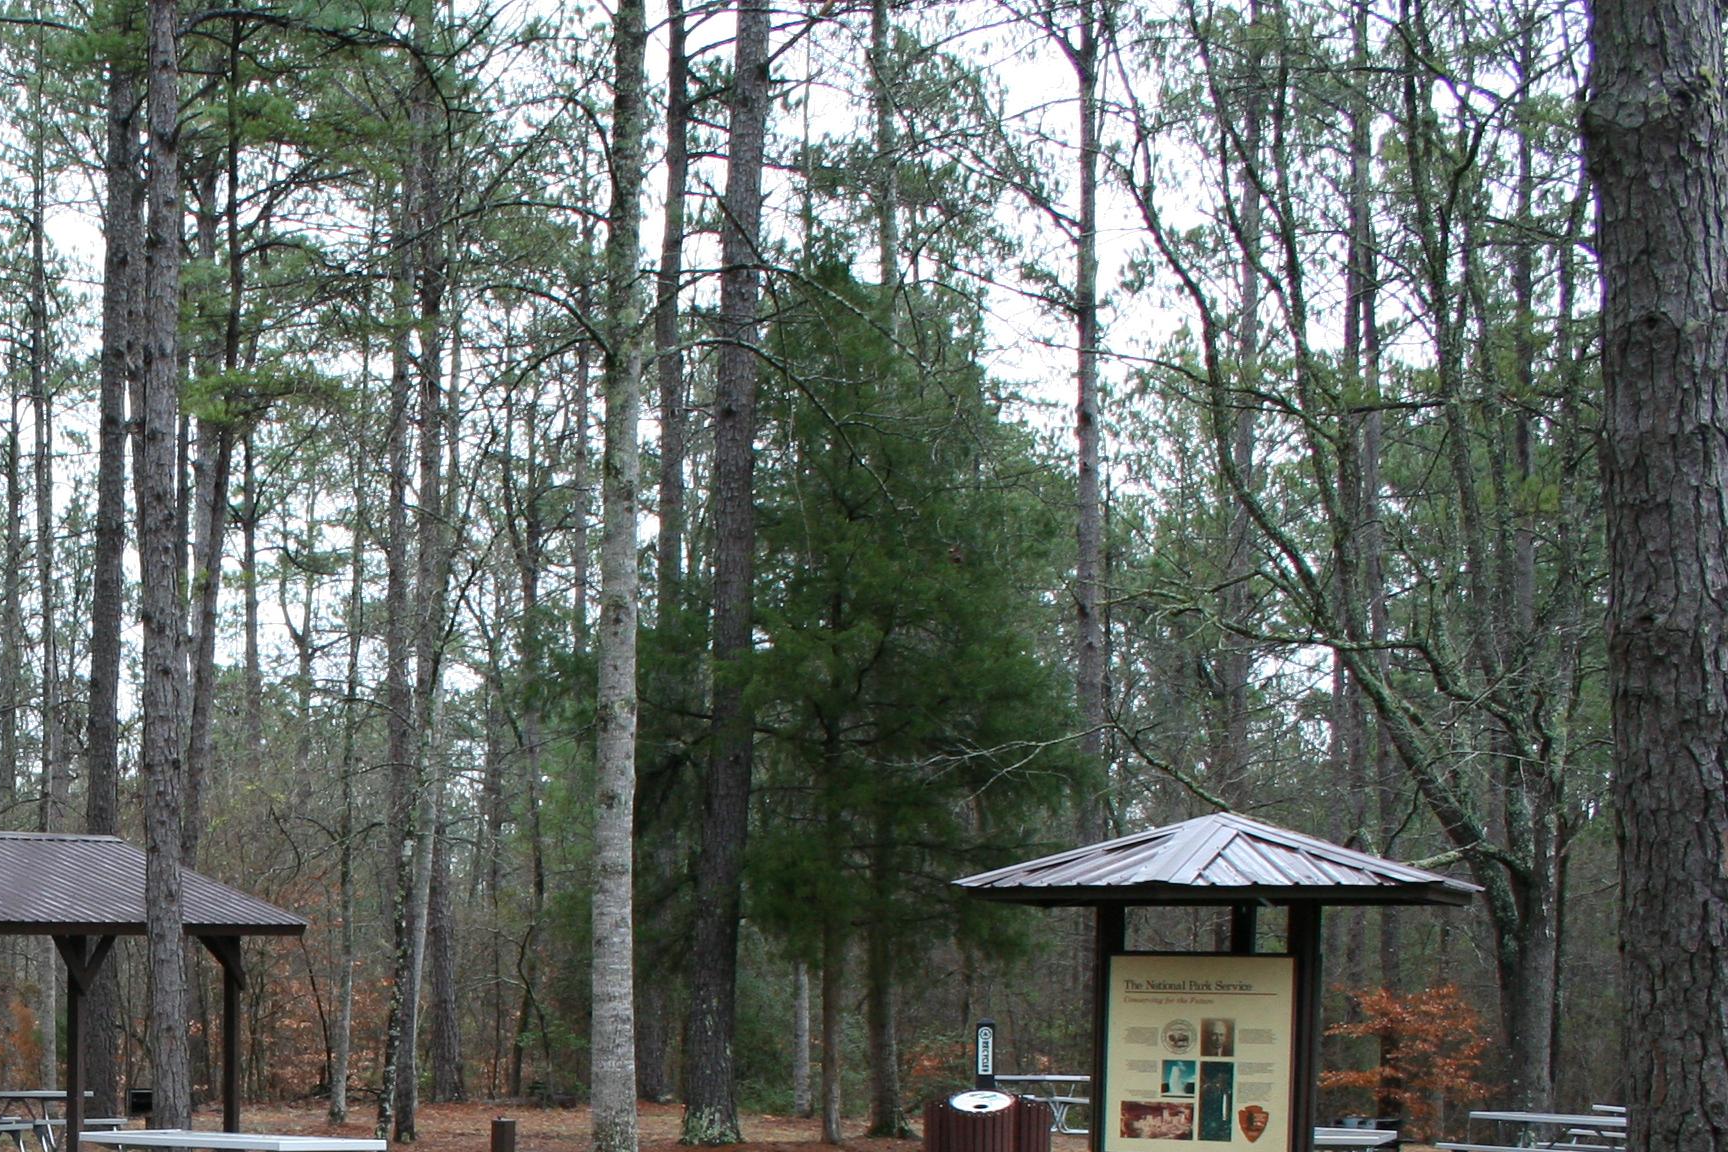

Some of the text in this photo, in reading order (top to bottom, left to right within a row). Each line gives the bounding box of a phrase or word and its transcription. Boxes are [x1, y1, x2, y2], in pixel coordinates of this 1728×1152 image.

[1124, 979, 1253, 992] The National Park Service
